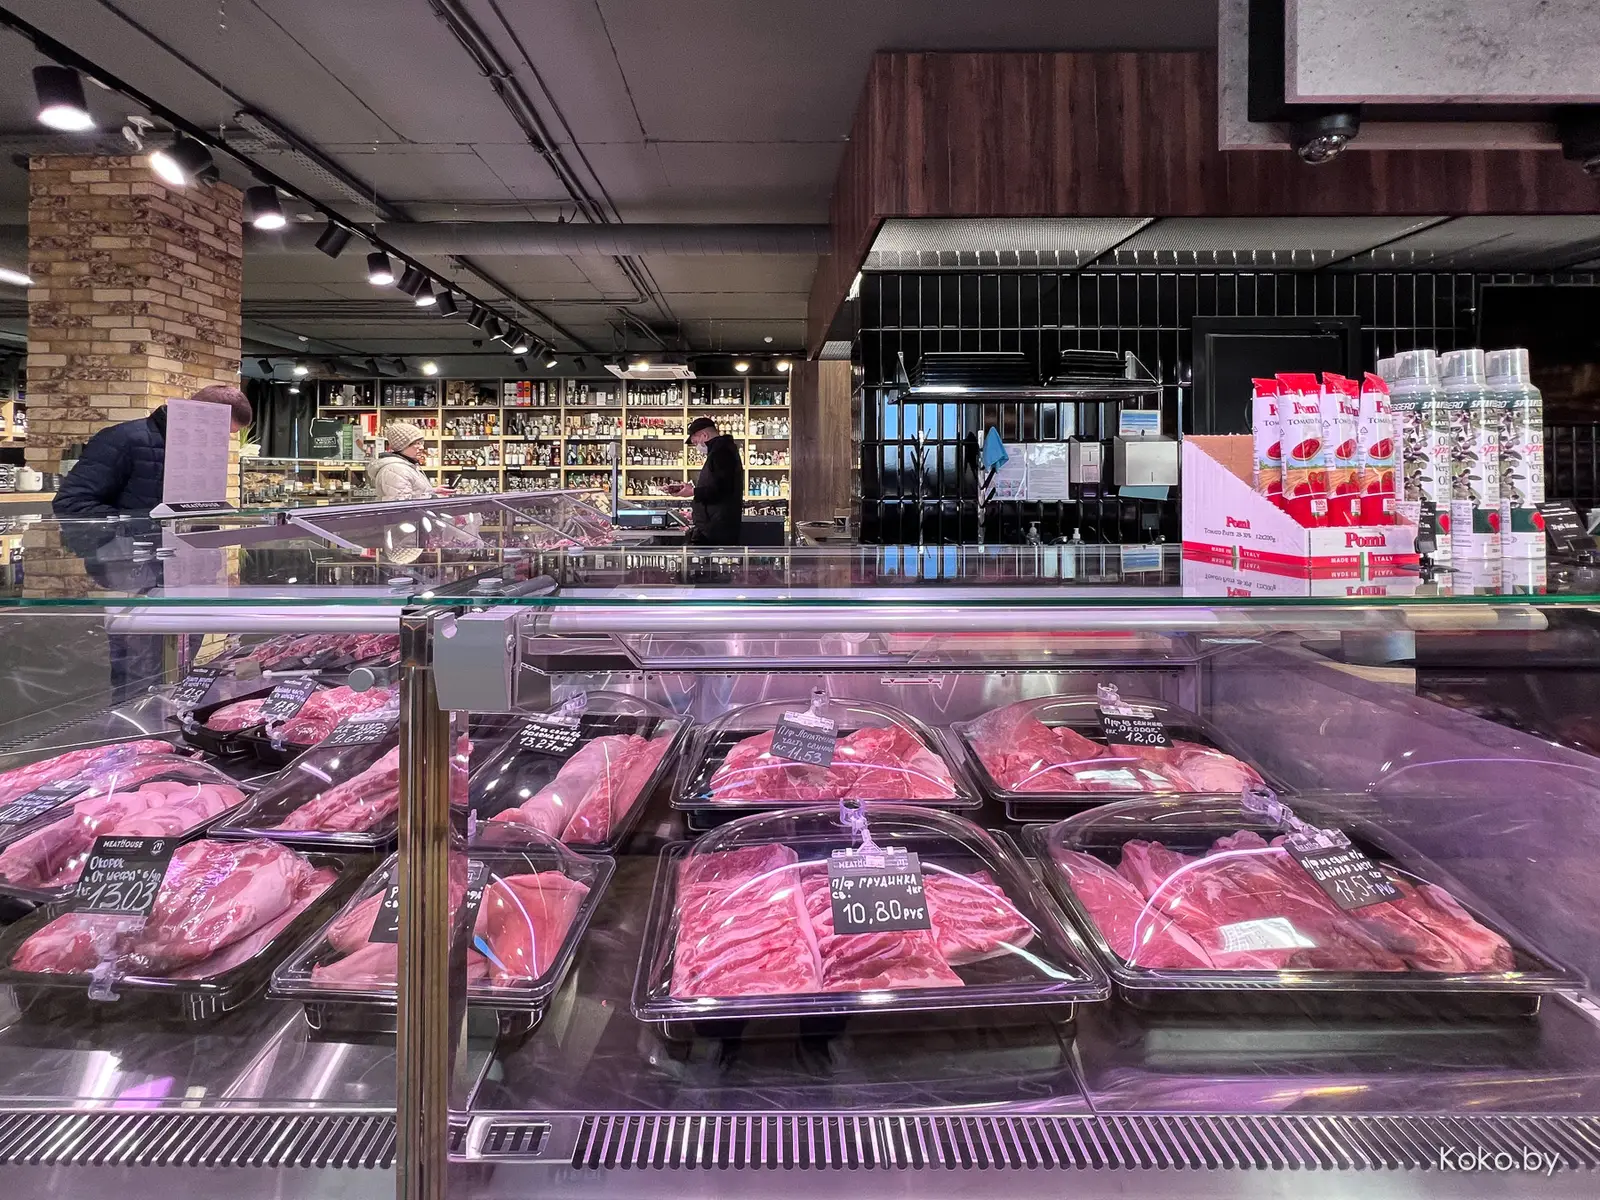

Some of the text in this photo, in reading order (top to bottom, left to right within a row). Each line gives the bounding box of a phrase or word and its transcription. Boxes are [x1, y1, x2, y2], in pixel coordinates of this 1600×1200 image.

[1344, 532, 1387, 548] Pomì
[1125, 732, 1166, 744] 12,06
[787, 746, 822, 764] 11,53
[103, 839, 144, 848] MEATHOUSE
[858, 874, 917, 888] ГРУДИНКА
[87, 880, 158, 911] 13,03
